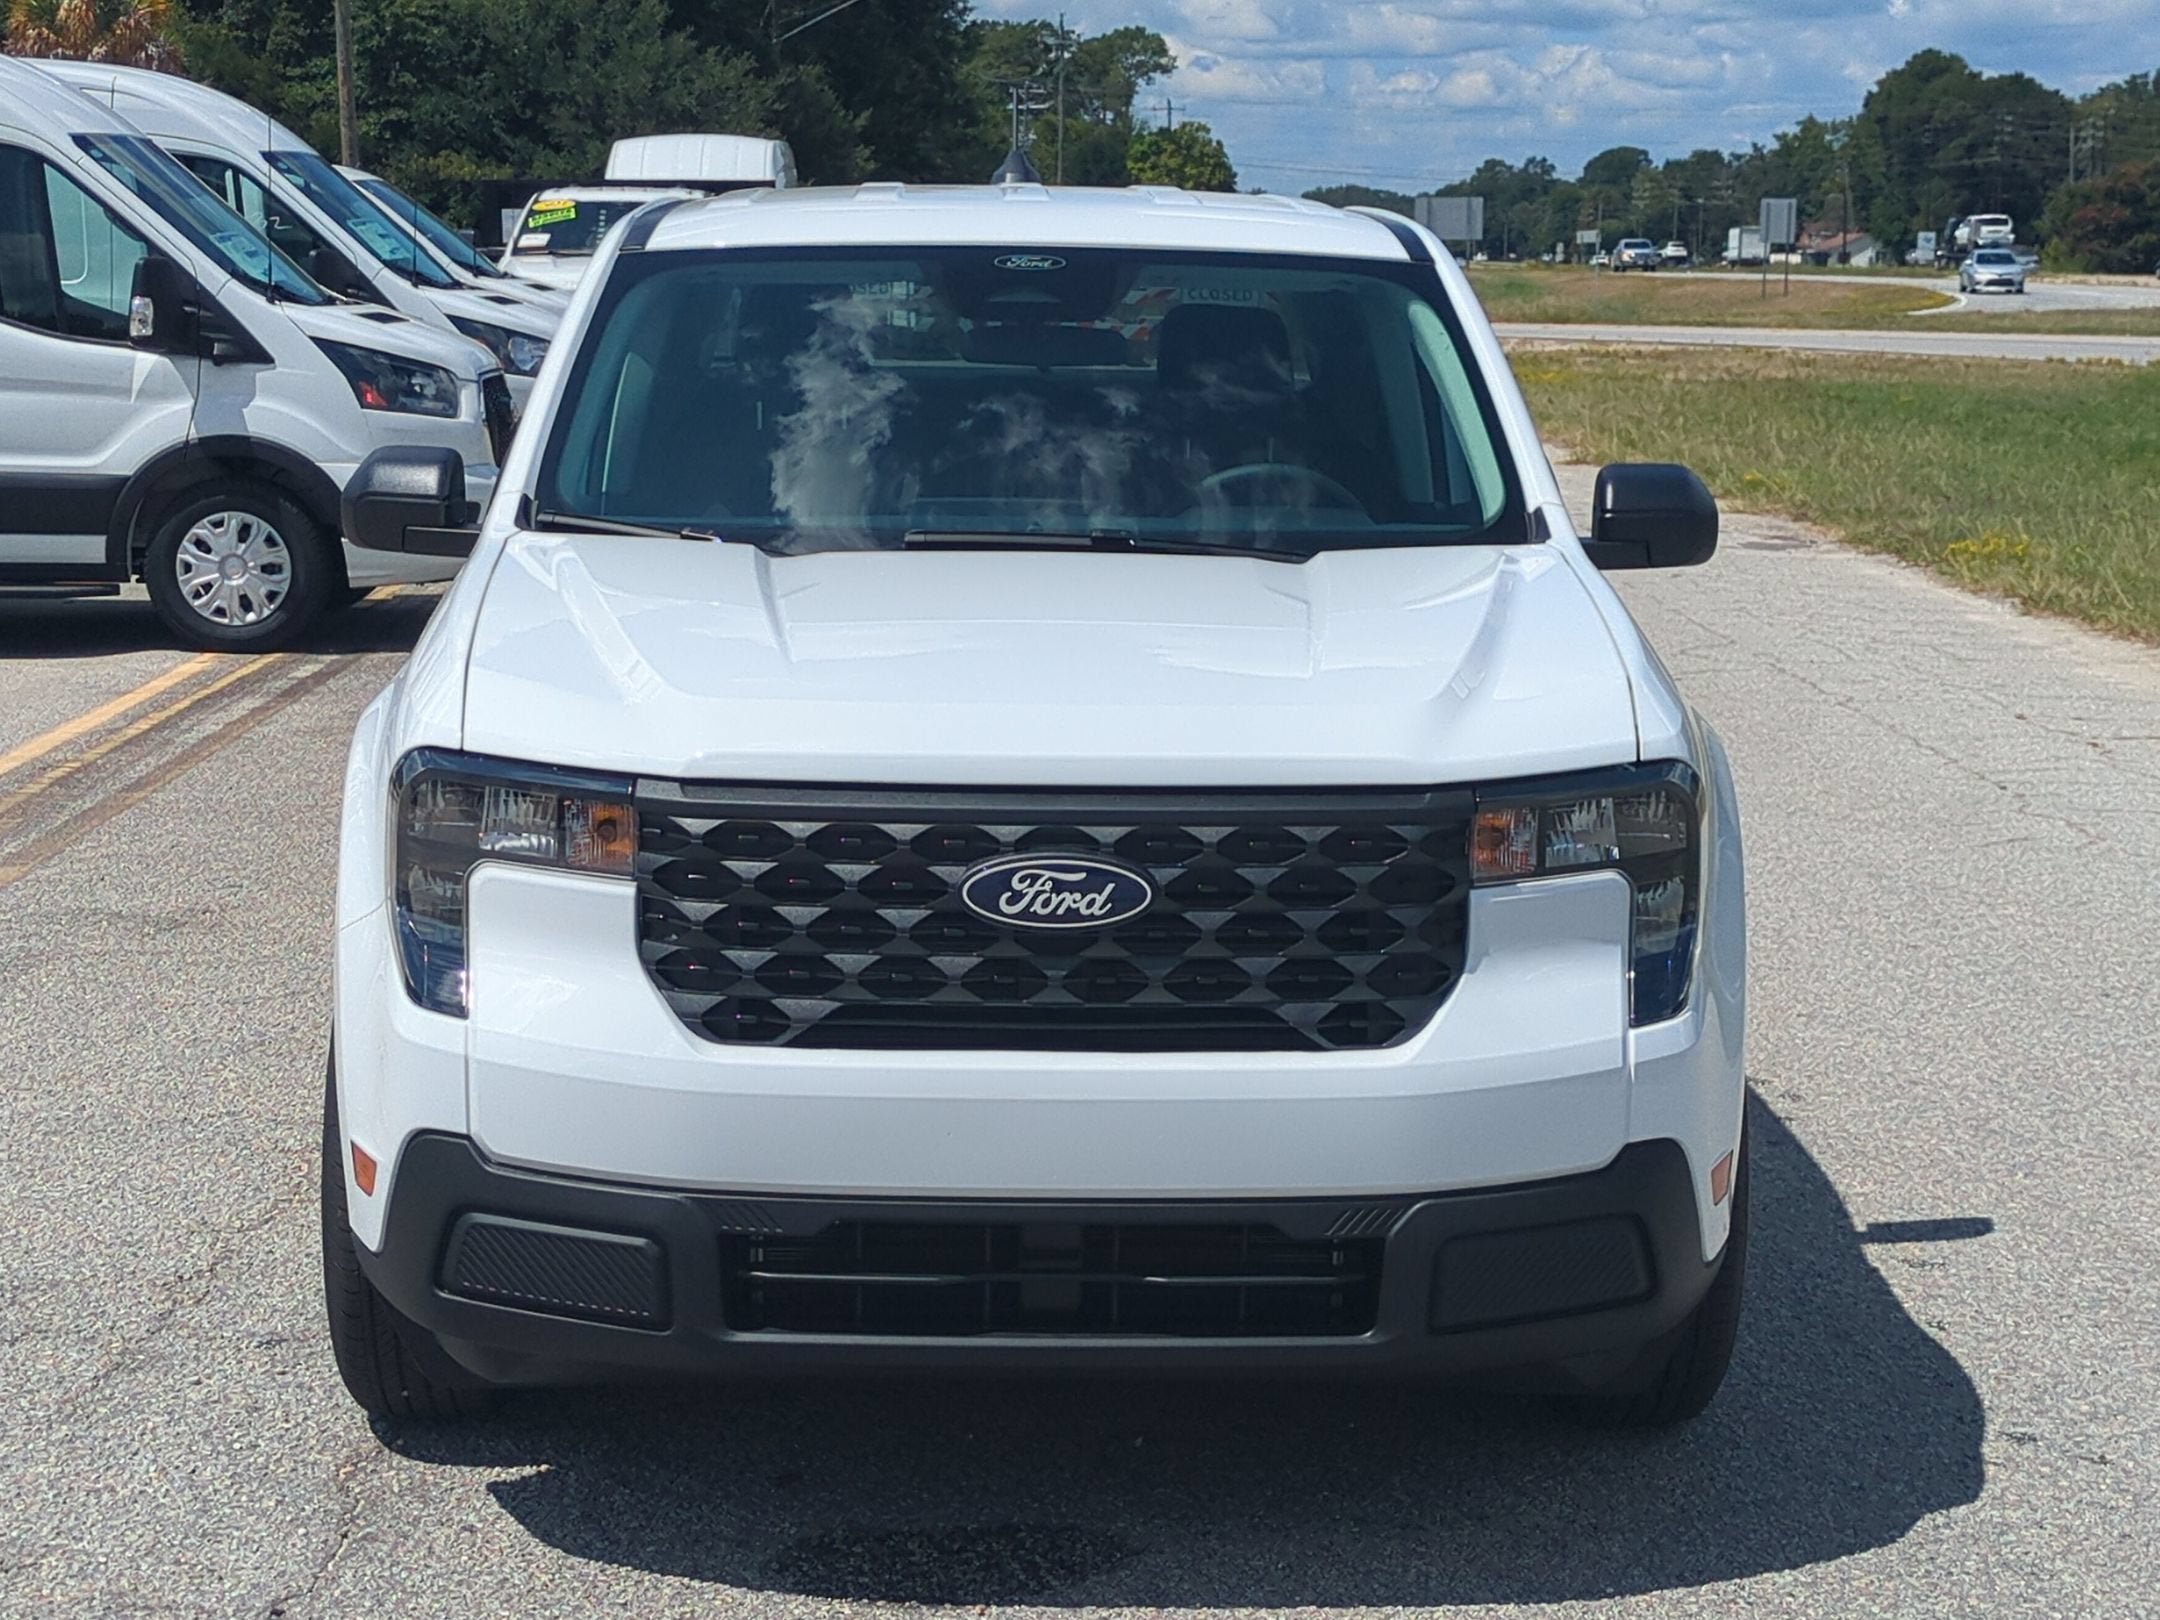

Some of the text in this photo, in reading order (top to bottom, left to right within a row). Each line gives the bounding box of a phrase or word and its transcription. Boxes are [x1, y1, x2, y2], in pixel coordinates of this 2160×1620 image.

[1006, 256, 1053, 268] Ford
[1187, 287, 1253, 301] CLOSED
[999, 869, 1116, 916] Ford
